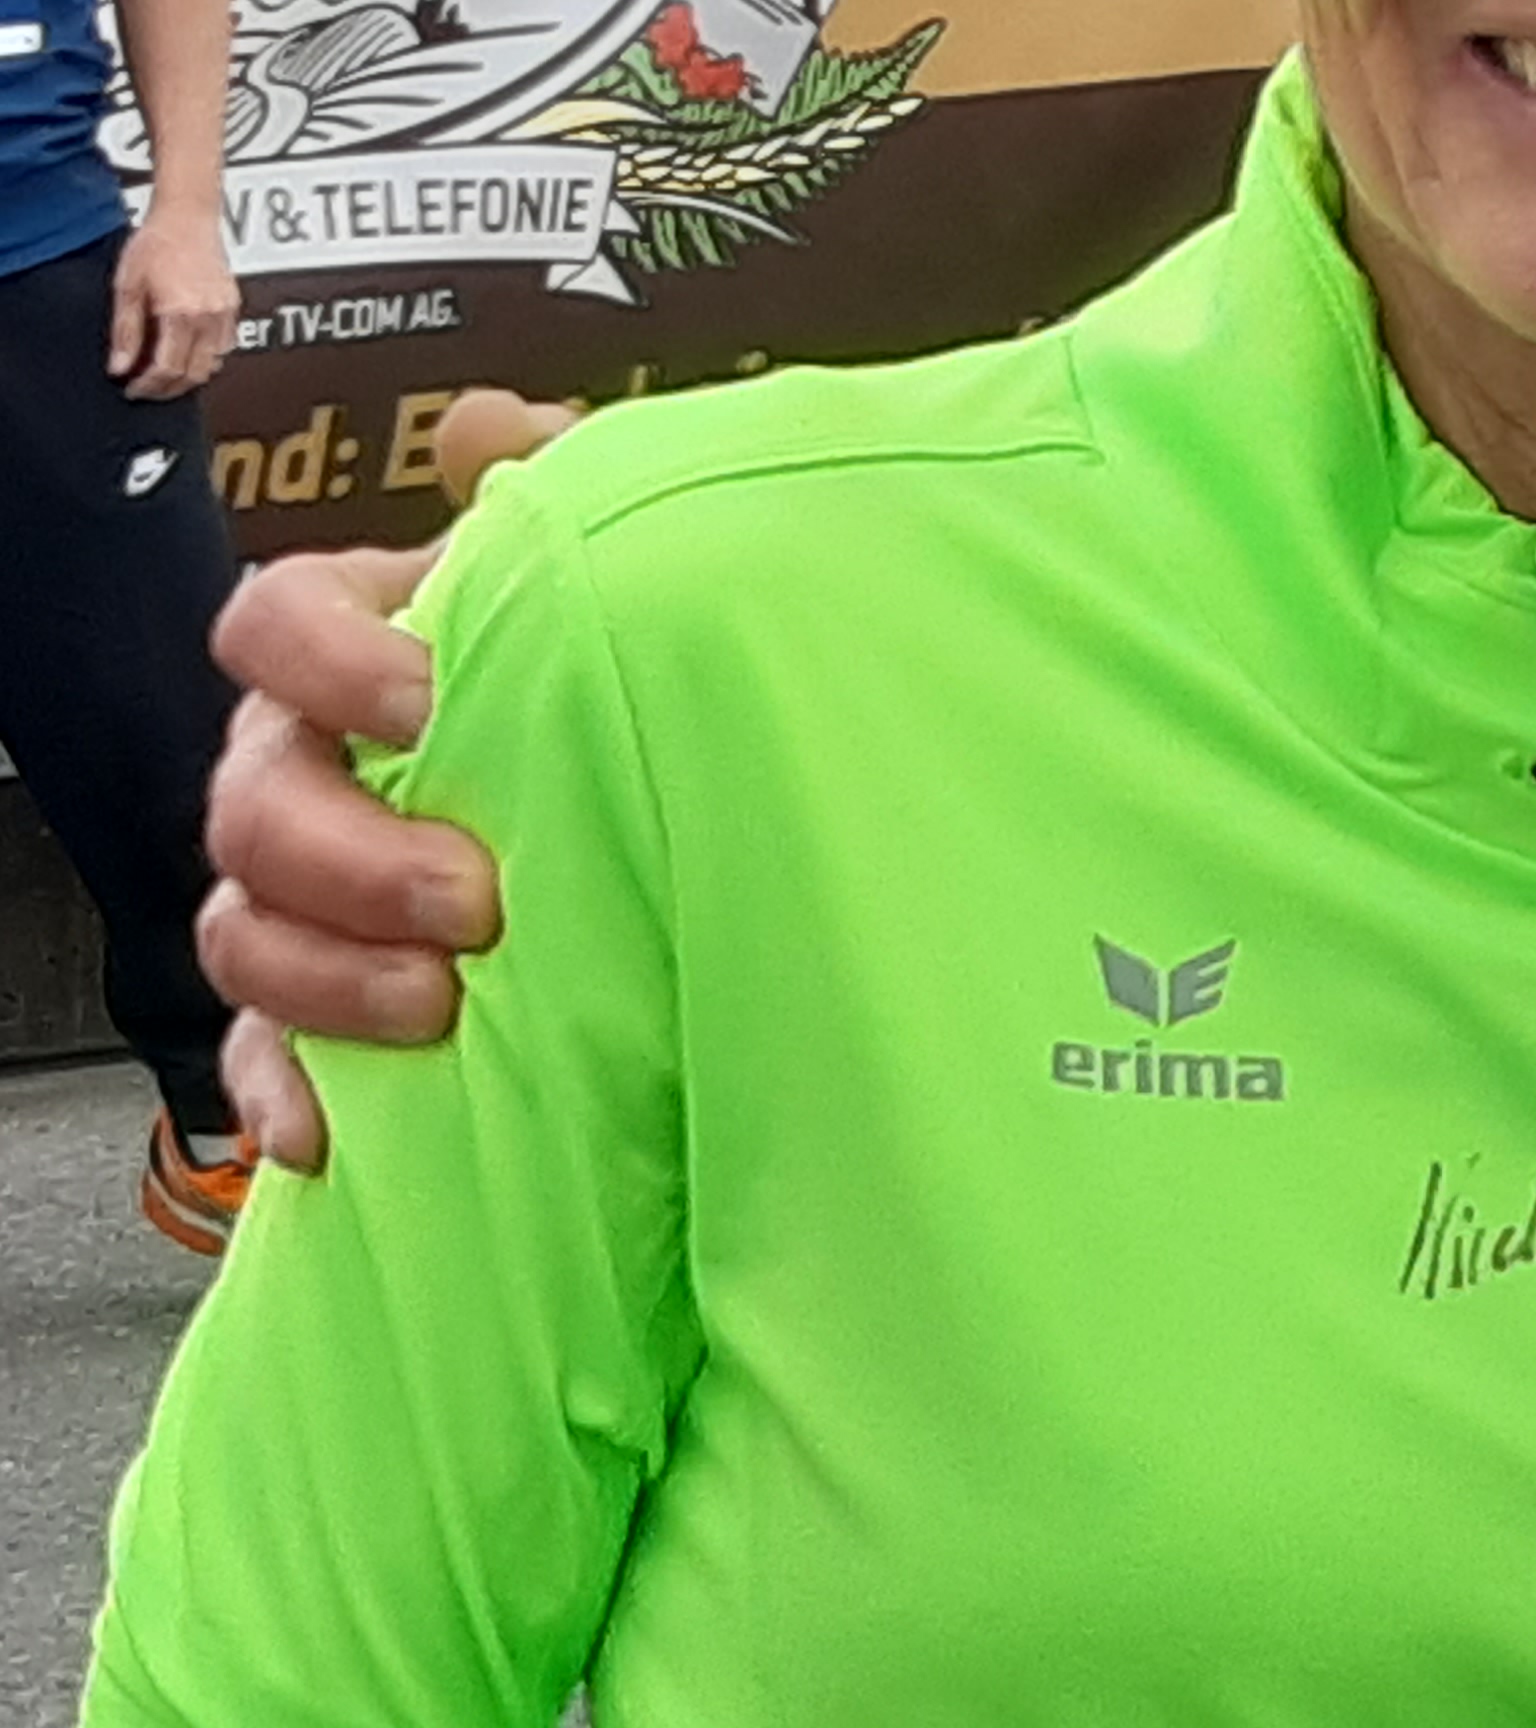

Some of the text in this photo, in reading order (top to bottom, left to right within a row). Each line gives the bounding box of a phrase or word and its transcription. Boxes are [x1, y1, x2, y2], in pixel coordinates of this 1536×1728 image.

[264, 187, 310, 244] &
[314, 178, 594, 239] TELEFONIE
[278, 293, 402, 346] TV-COM
[1051, 1038, 1284, 1102] erima
